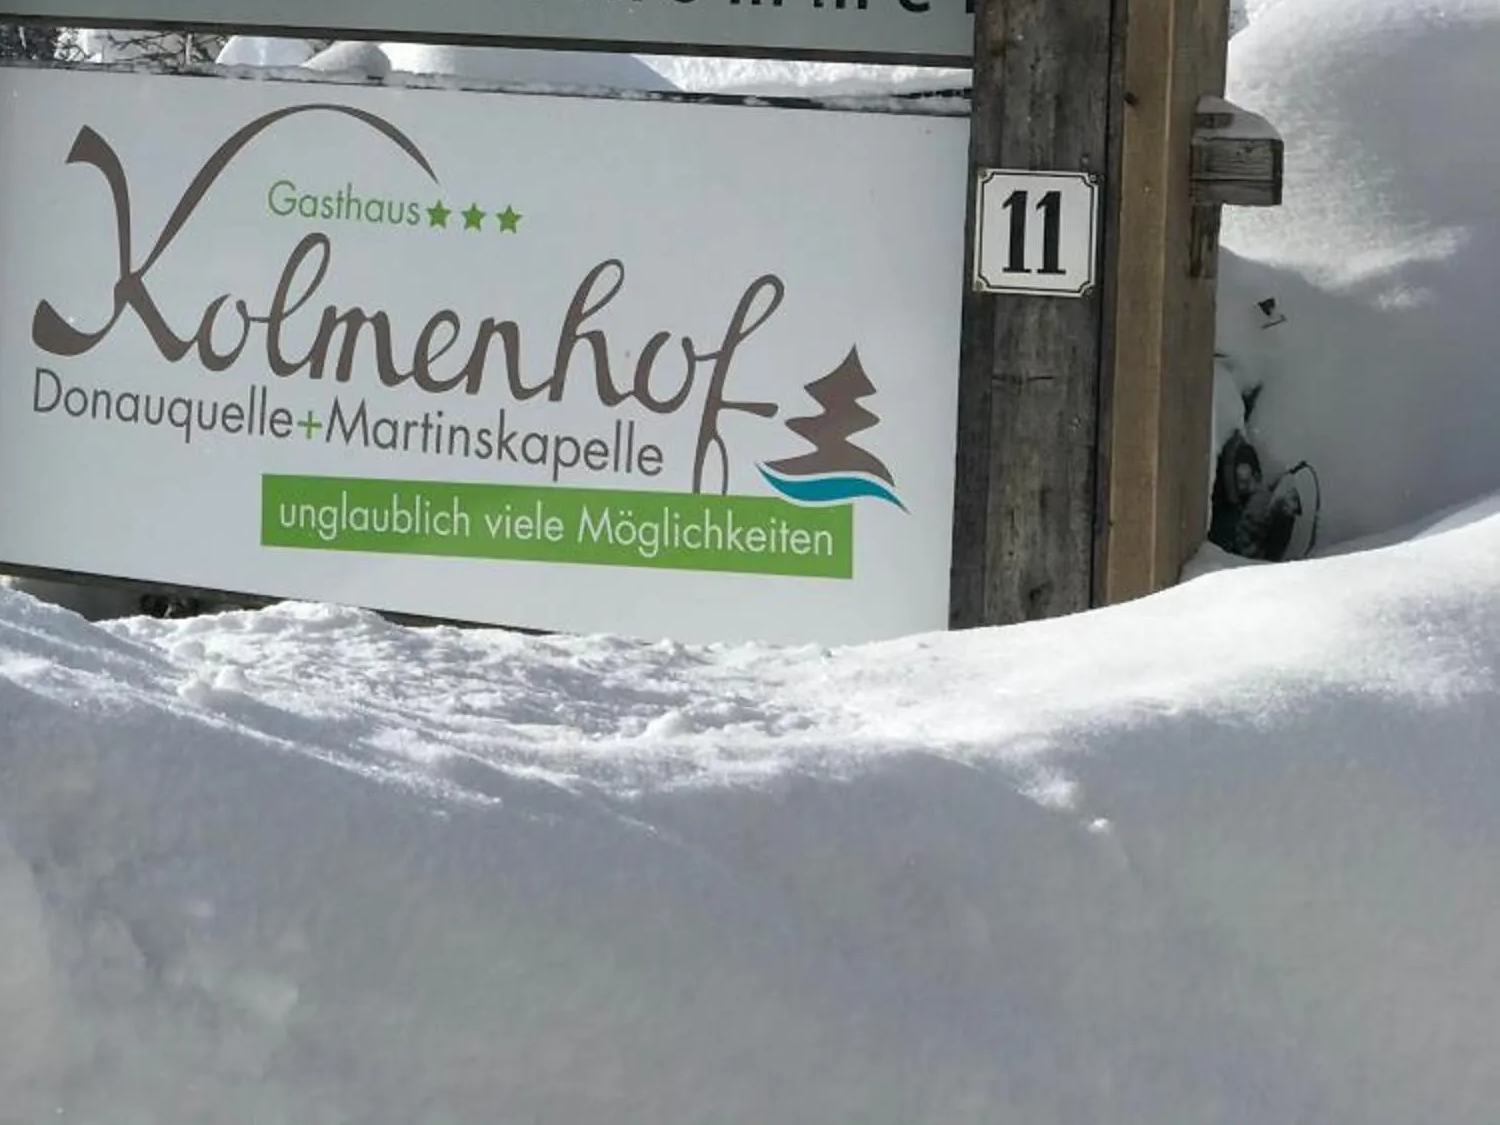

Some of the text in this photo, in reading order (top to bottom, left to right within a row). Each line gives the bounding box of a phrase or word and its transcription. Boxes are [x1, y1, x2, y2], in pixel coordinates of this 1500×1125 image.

[267, 180, 421, 227] Gasthaus
[1001, 189, 1067, 275] 11
[31, 103, 785, 496] Kolmenhof
[279, 491, 834, 558] unglaublich viele Möglichkeiten
